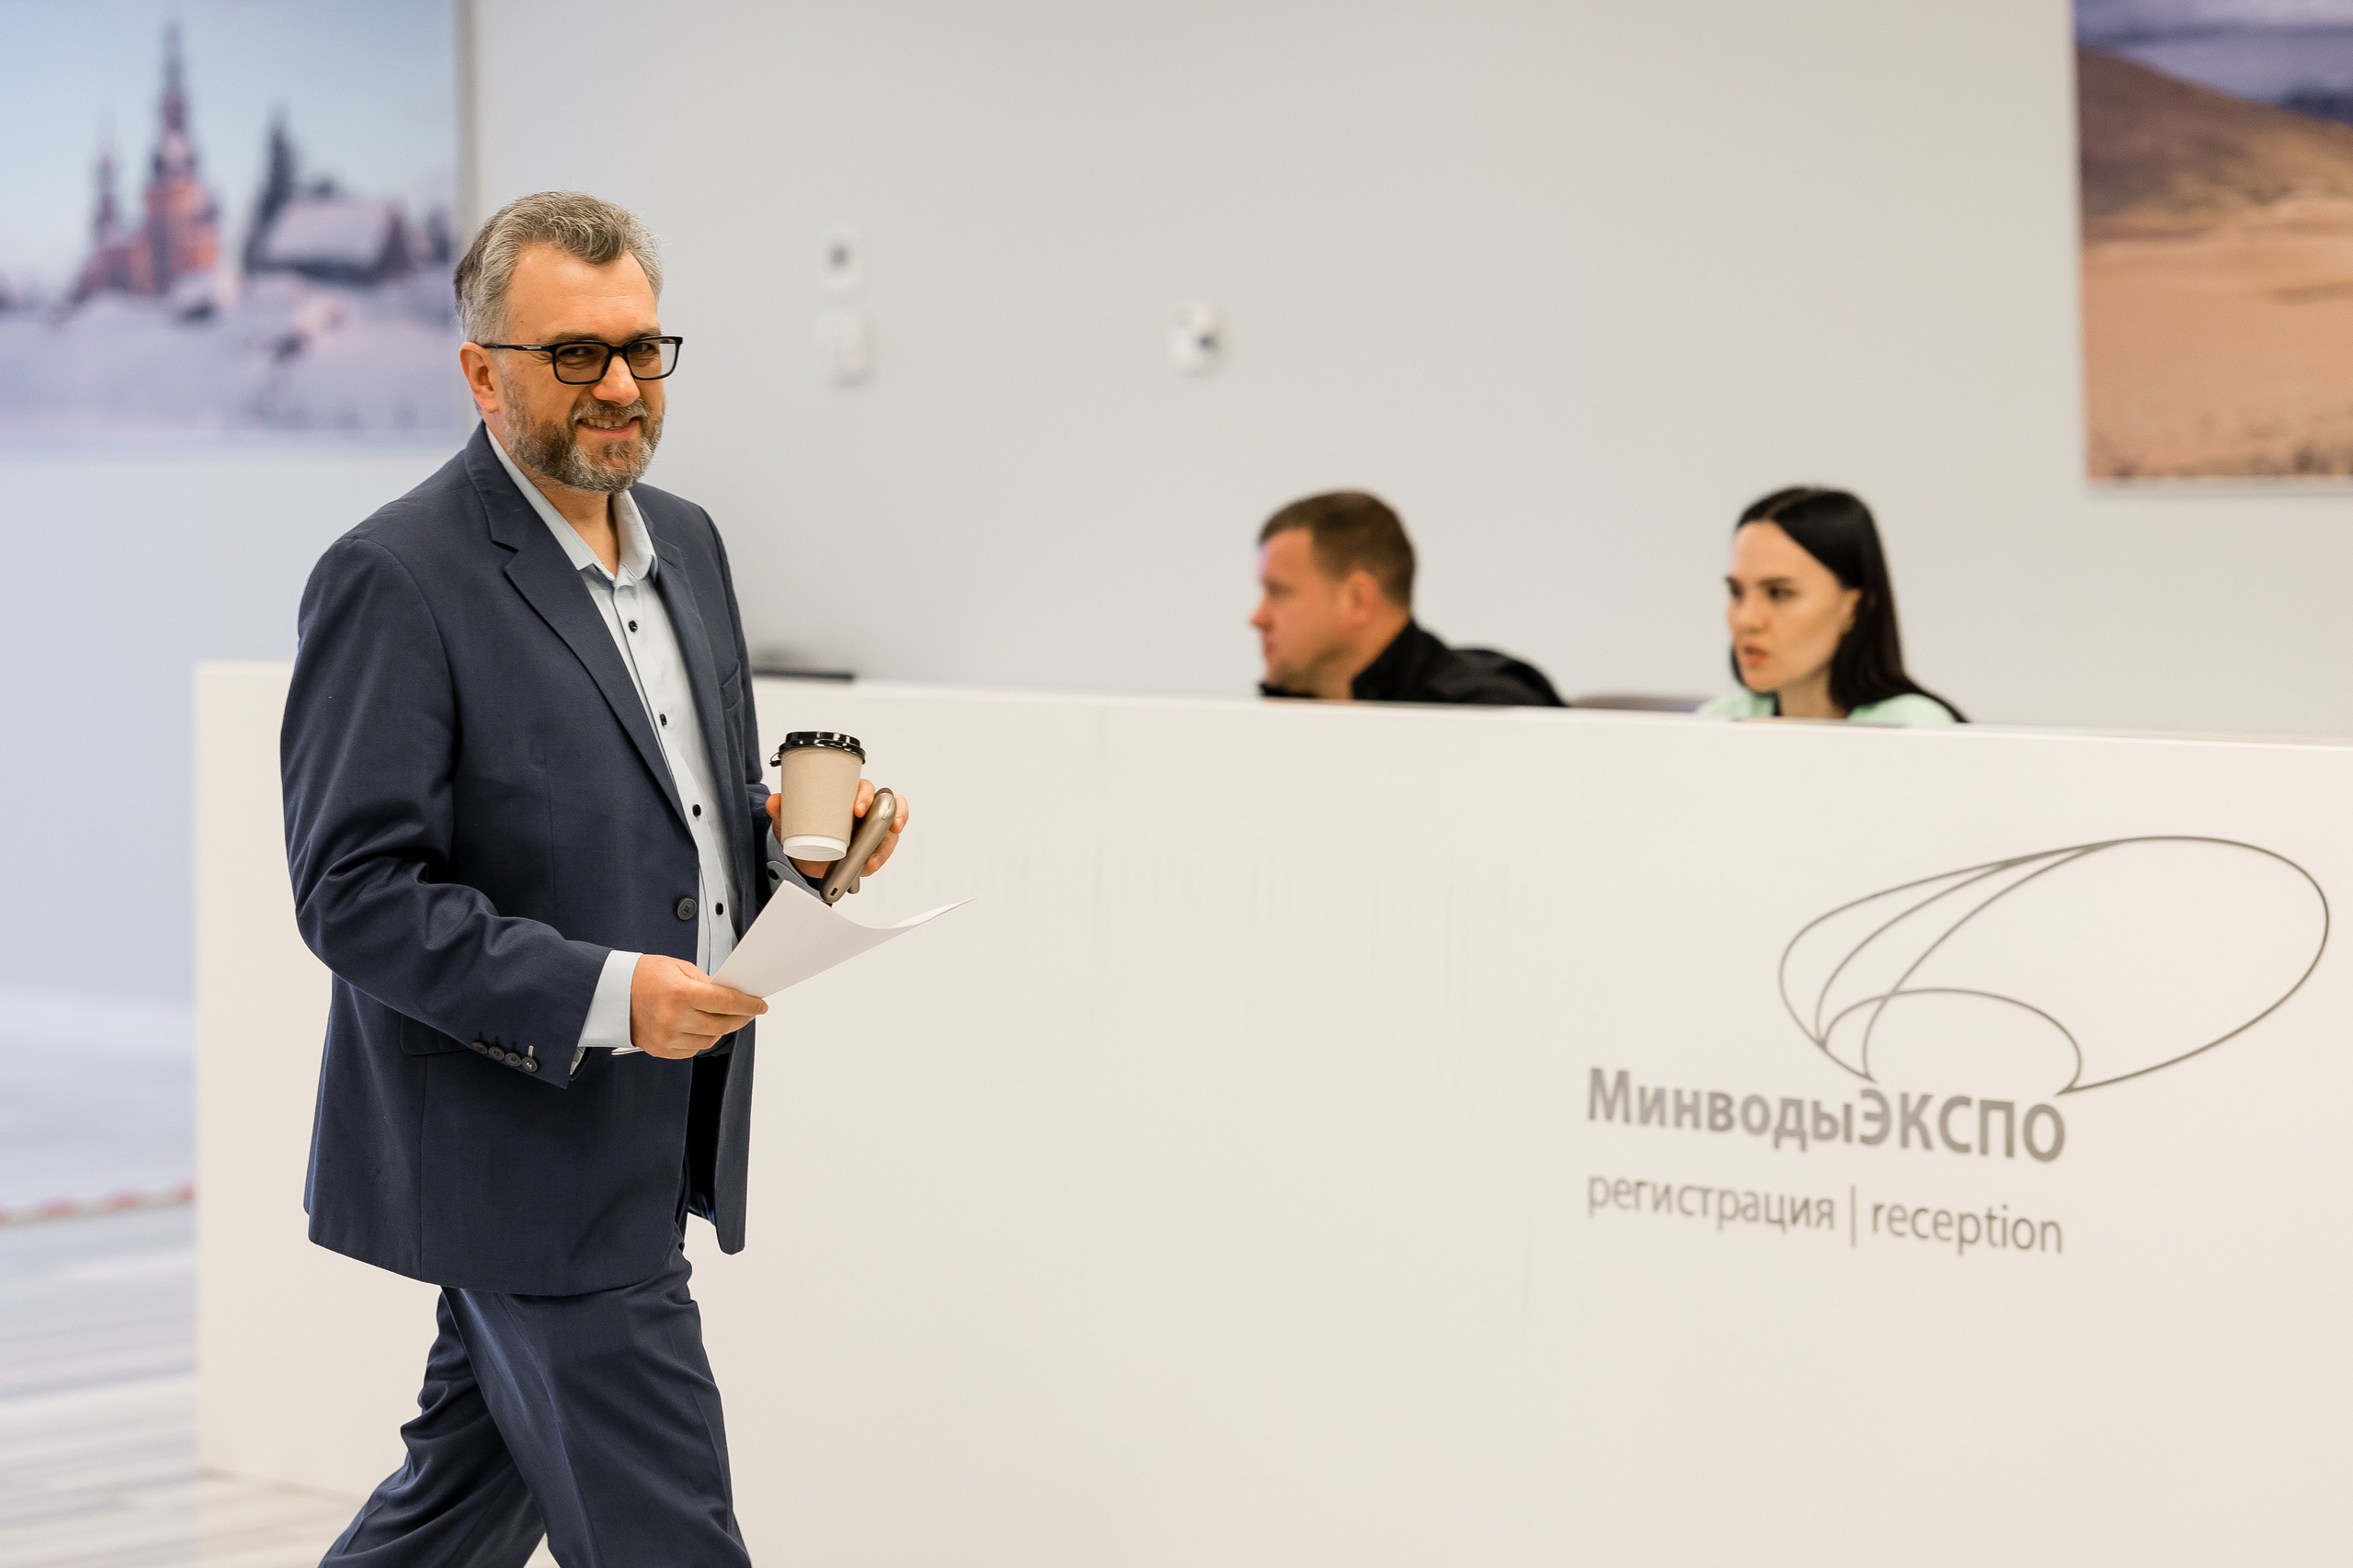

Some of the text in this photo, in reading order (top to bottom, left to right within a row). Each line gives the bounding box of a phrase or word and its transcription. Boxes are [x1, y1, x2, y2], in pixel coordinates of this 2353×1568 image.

[1587, 1066, 2066, 1164] МинводыЭКСПО
[1587, 1176, 2063, 1256] регистрация reception
